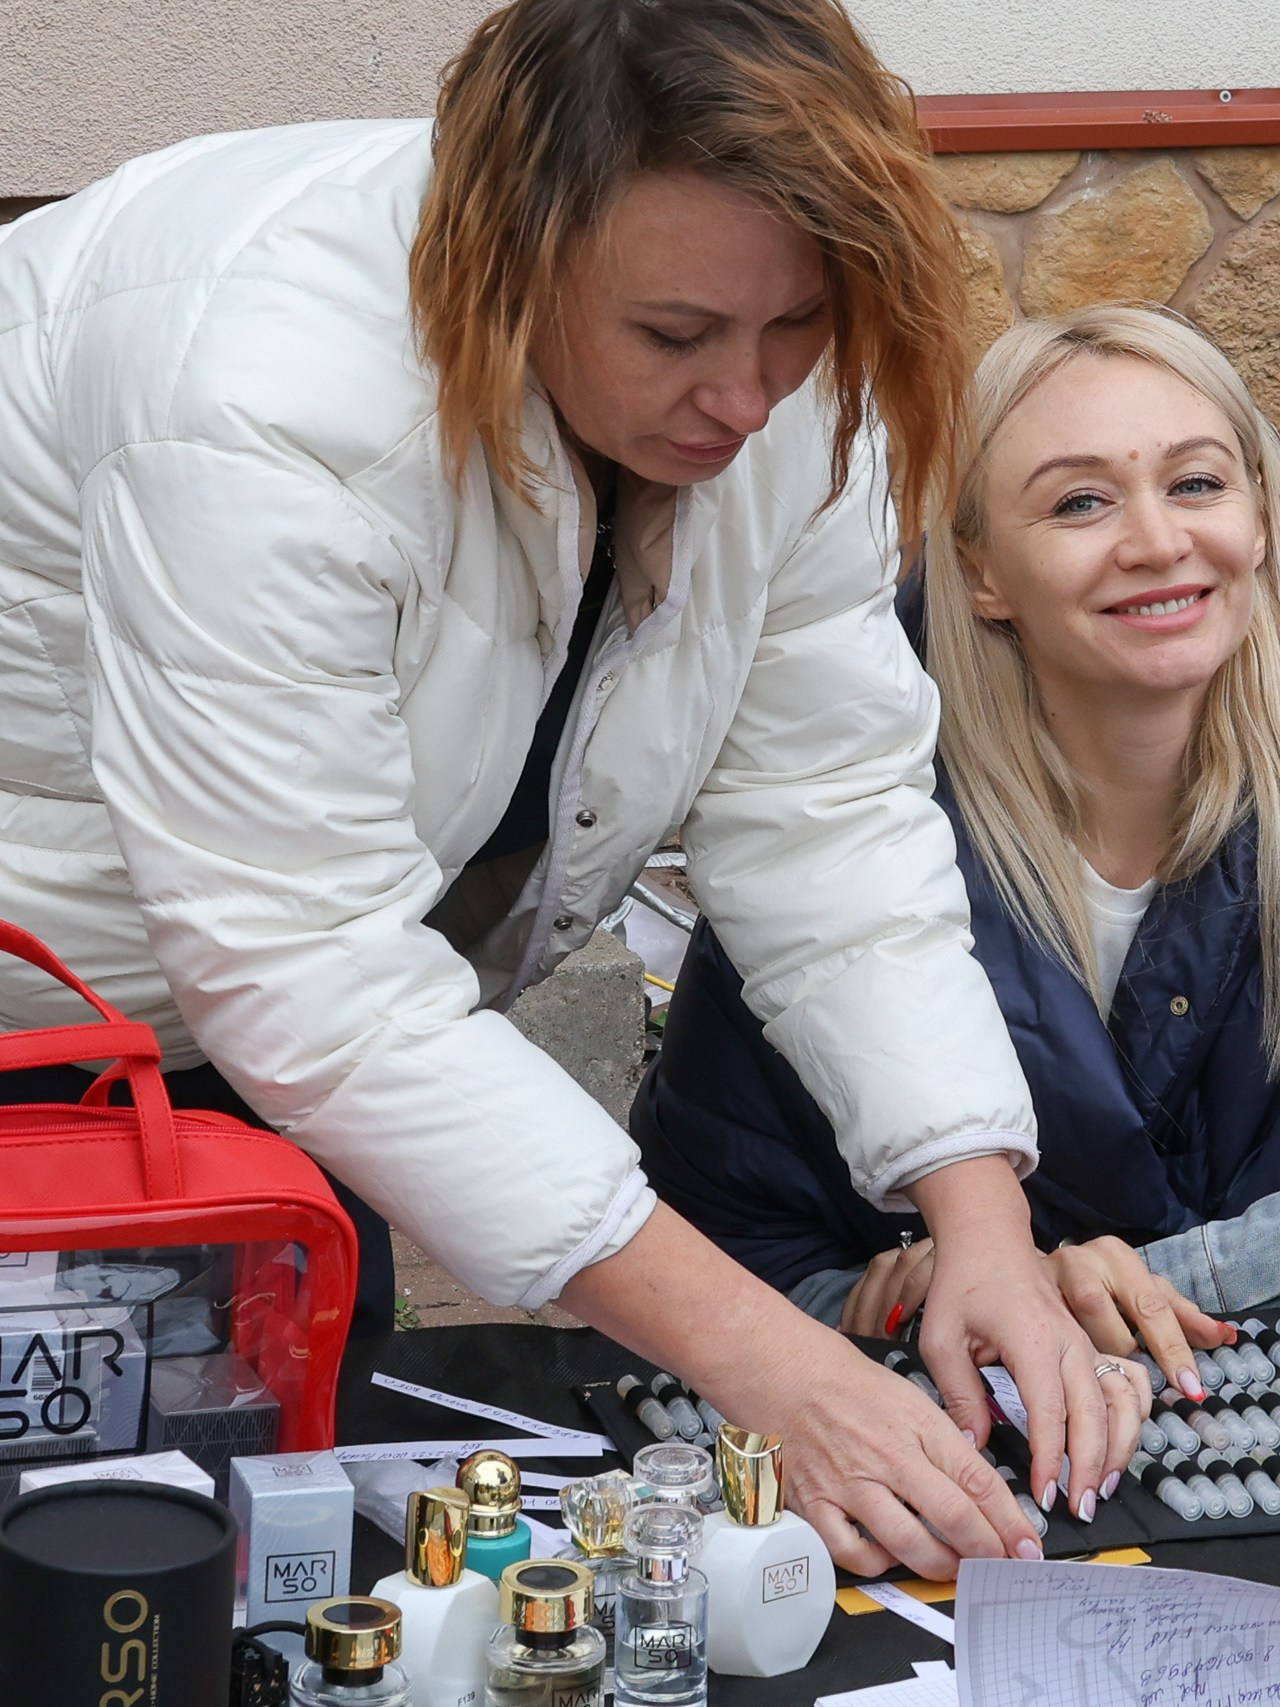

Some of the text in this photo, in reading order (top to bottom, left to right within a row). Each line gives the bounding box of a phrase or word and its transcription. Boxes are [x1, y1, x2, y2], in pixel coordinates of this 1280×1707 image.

[0, 1328, 125, 1384] AR
[274, 1560, 327, 1579] MAR
[768, 1564, 804, 1584] MAR
[282, 1577, 318, 1594] SO
[774, 1578, 797, 1595] SO
[152, 1614, 160, 1670] COLLECTION
[640, 1633, 686, 1649] MAR
[648, 1649, 679, 1664] SO
[559, 1687, 597, 1707] MAR
